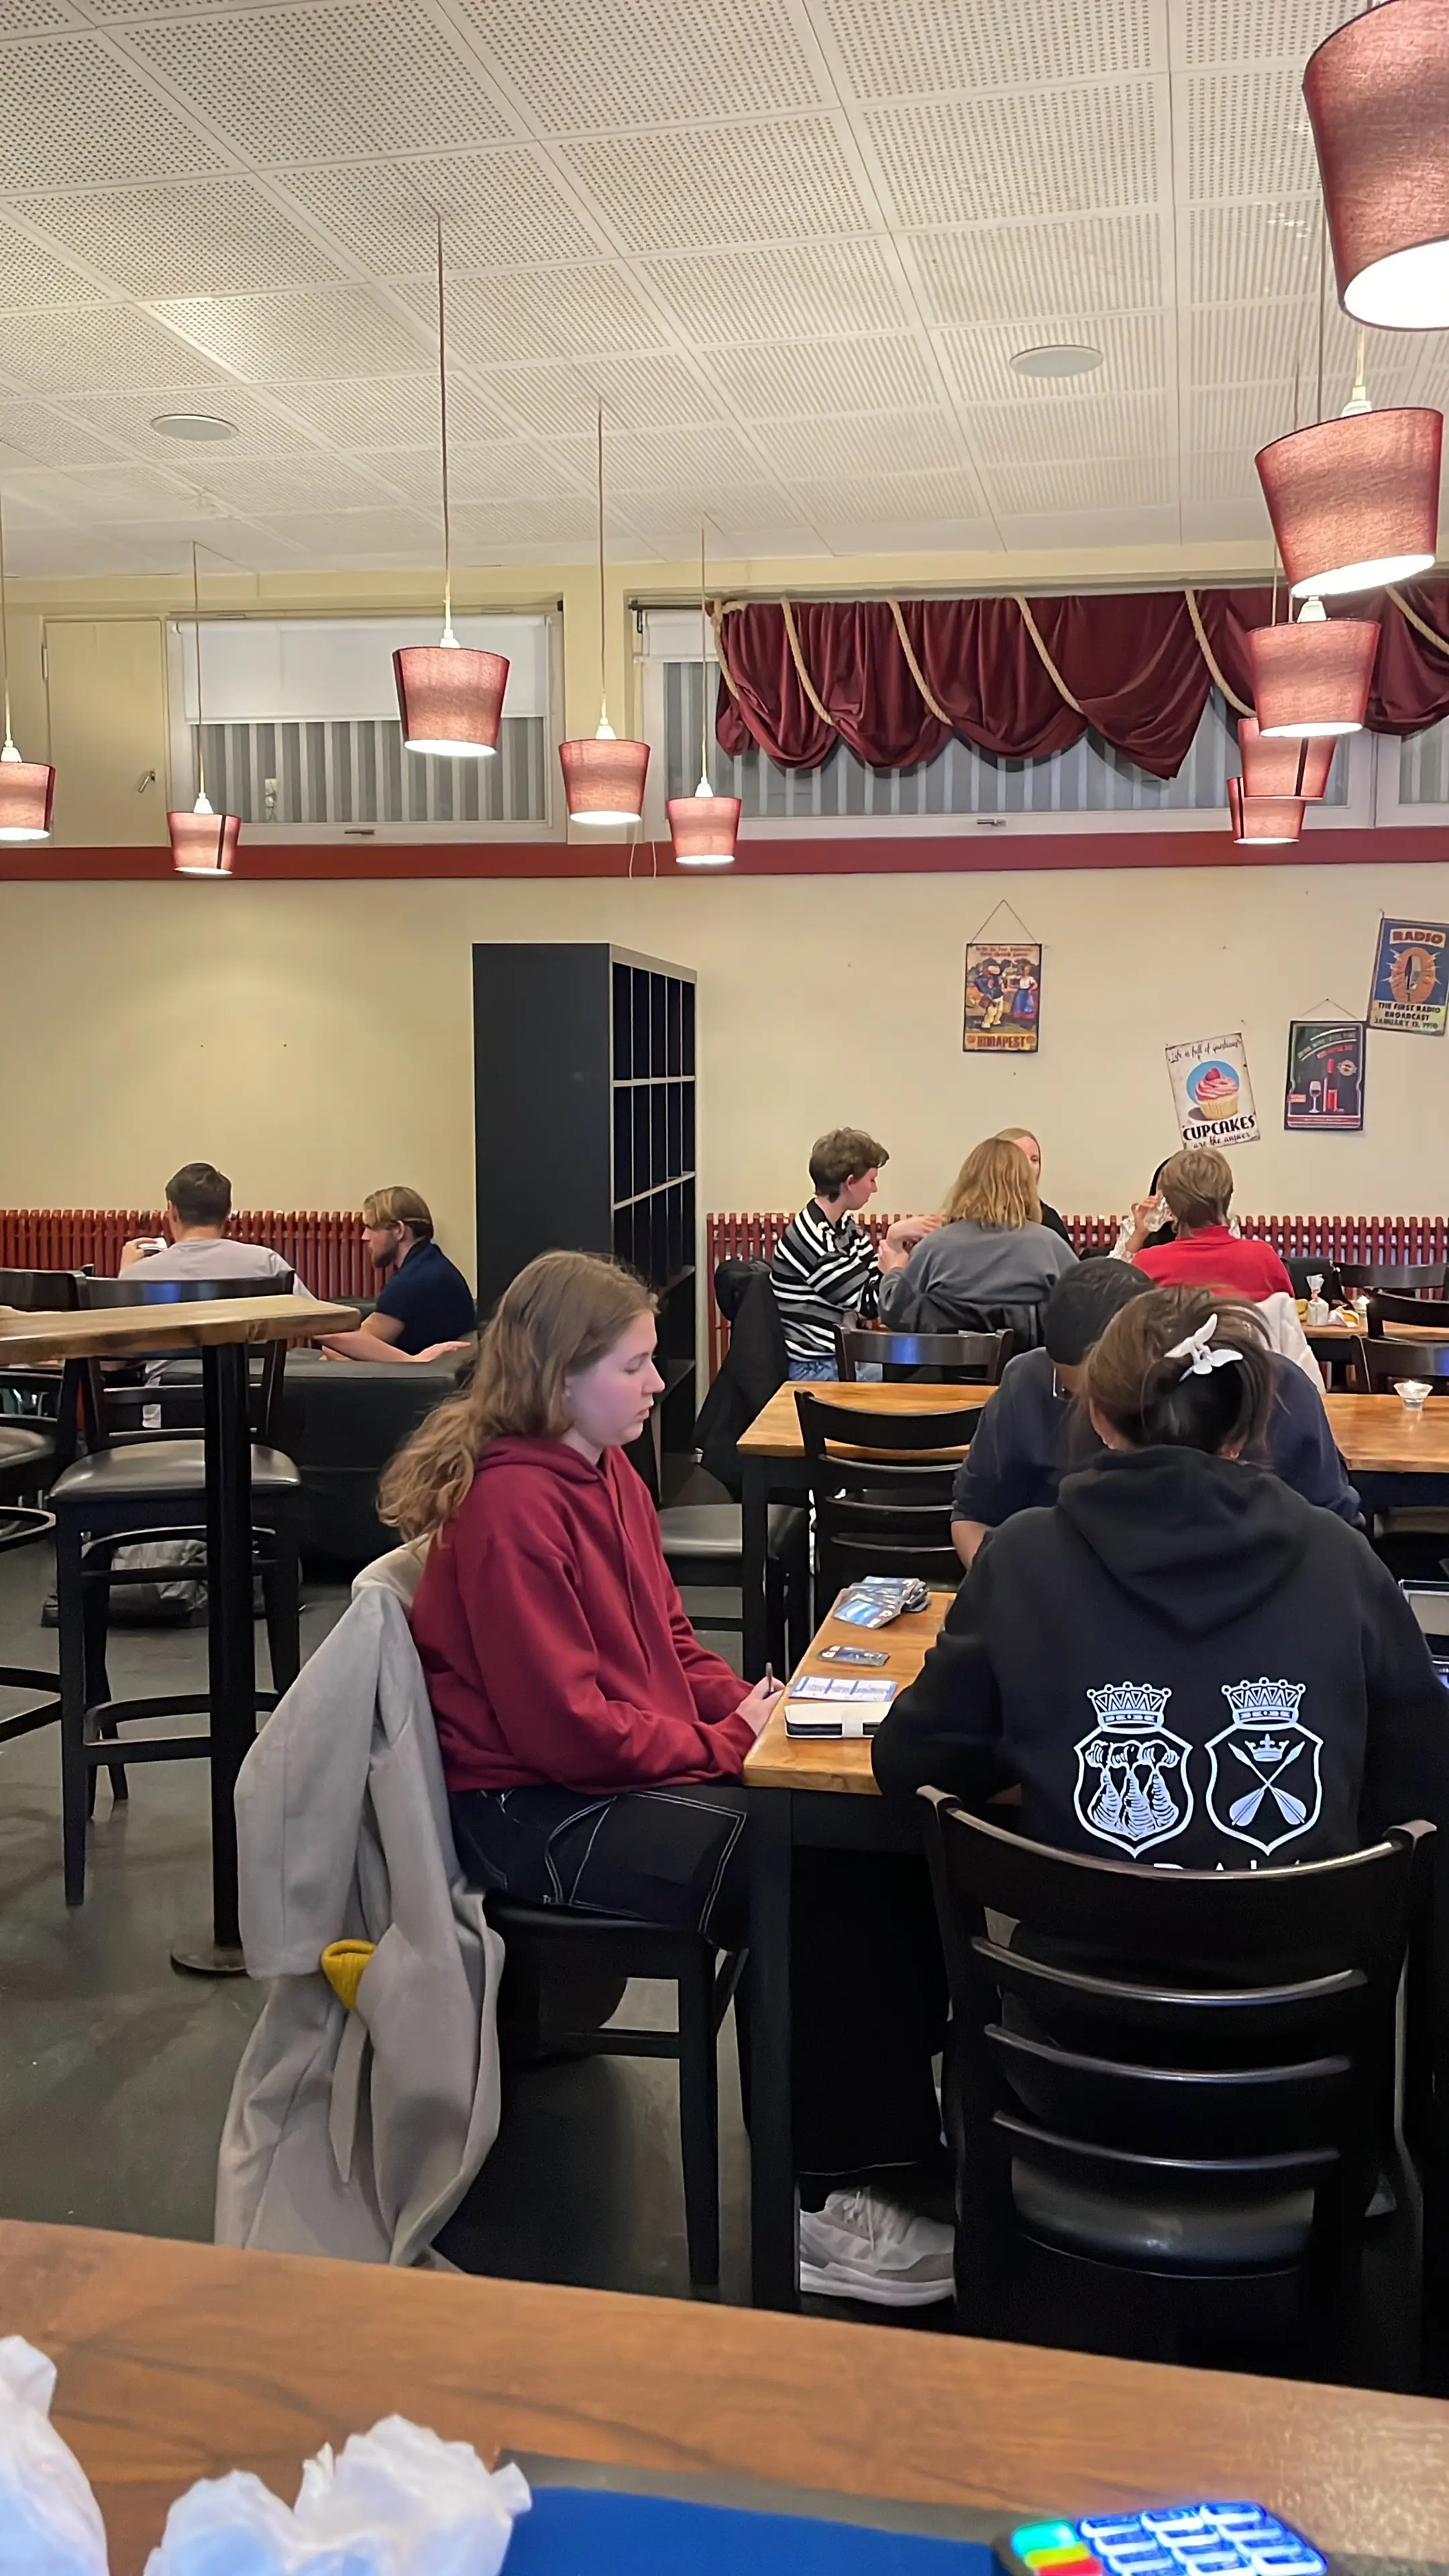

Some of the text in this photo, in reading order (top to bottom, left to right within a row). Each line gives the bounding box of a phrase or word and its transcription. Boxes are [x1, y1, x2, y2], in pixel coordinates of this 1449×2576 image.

[1393, 931, 1444, 945] RADIO
[1393, 1004, 1415, 1012] FIRST
[1416, 1006, 1441, 1014] RADIO
[1375, 1016, 1409, 1026] JANUARY
[1385, 1011, 1430, 1021] BROADCAST
[977, 1036, 1026, 1048] BUDAPEST
[1192, 1044, 1203, 1059] full
[1204, 1042, 1210, 1055] of
[1183, 1115, 1255, 1140] CUPCAKES
[1194, 1141, 1206, 1149] are
[1210, 1136, 1220, 1146] the
